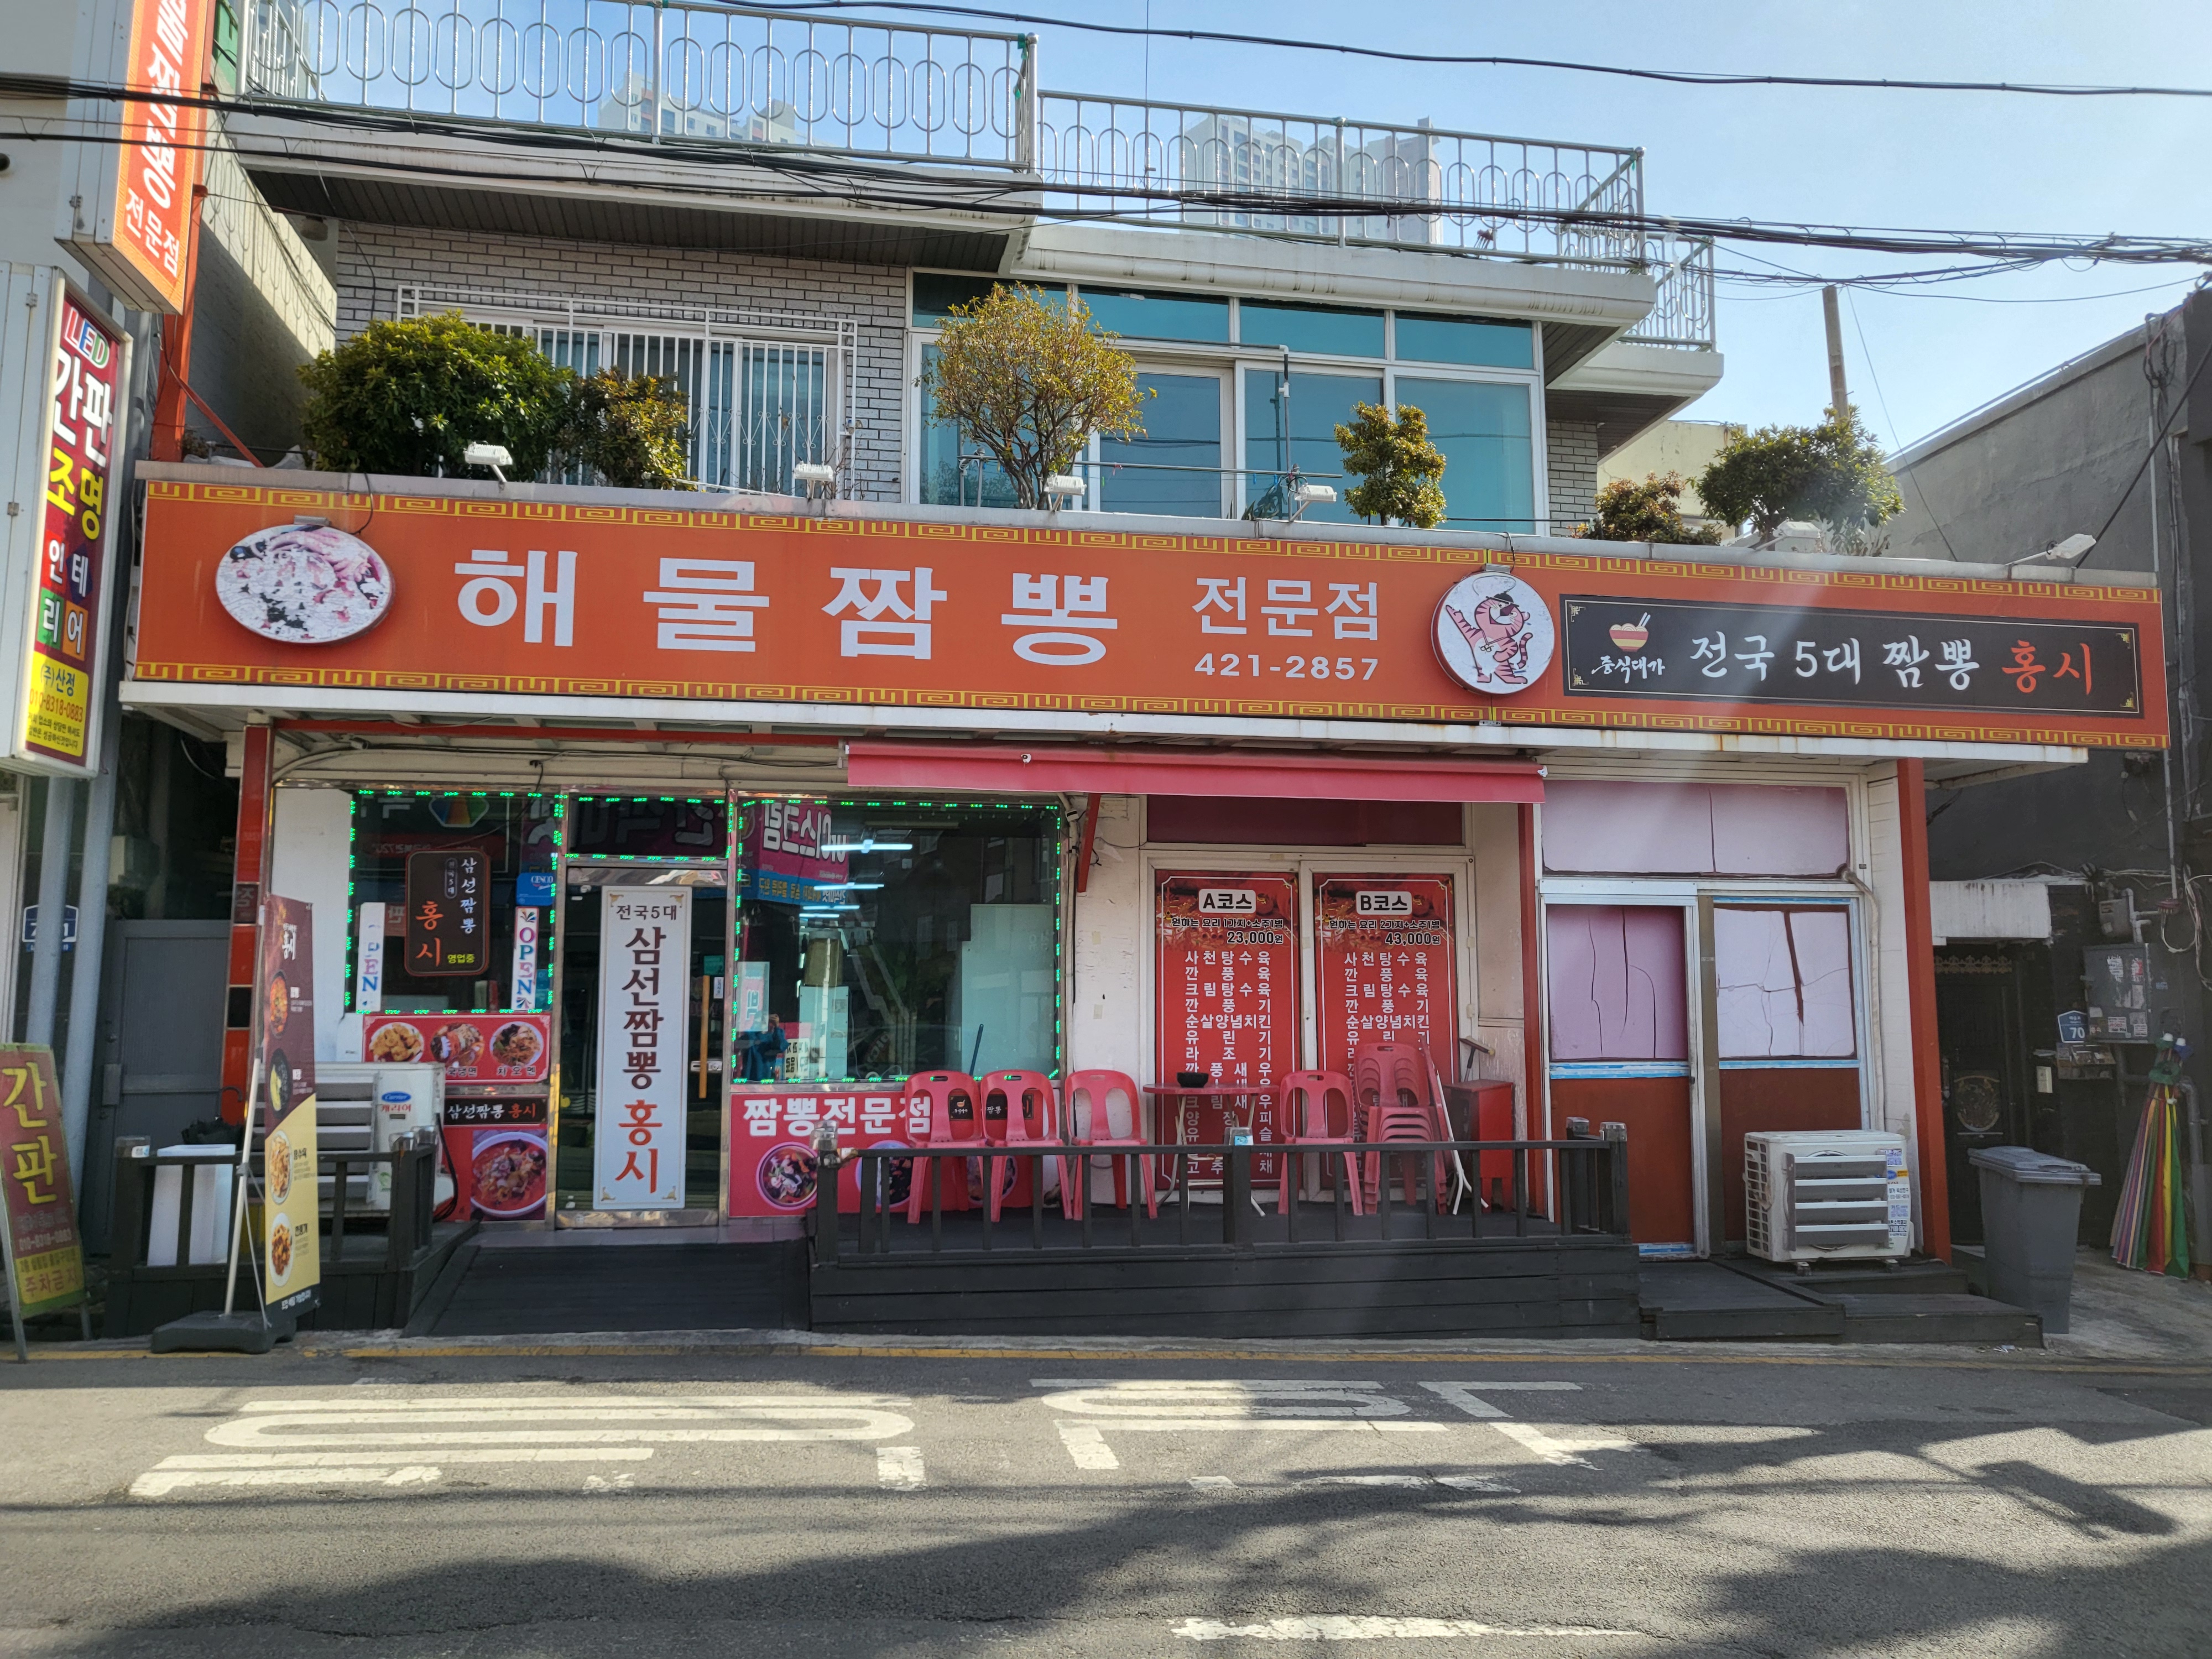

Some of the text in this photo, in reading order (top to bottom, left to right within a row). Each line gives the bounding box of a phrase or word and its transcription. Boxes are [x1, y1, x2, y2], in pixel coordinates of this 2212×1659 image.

[126, 187, 179, 278] 전문점
[64, 306, 109, 369] LED
[54, 346, 112, 468] 간판
[47, 447, 103, 540] 조명
[1192, 577, 1378, 640] 전문점
[1194, 653, 1379, 681] 421-2857
[1592, 654, 1666, 684] 중식대가
[1691, 630, 2092, 695] 전국 5대 짬뽕 홍시
[460, 857, 478, 935] 삼선짬뽕
[1203, 893, 1253, 909] A코스
[1360, 895, 1408, 911] B코스
[617, 904, 678, 922] 전국5대
[1172, 918, 1199, 927] 원하는
[1203, 918, 1220, 927] 요리
[1329, 920, 1356, 929] 원하는
[1360, 920, 1377, 929] 요리
[415, 901, 444, 967] 홍시
[1227, 931, 1283, 945] 23,000원
[1385, 933, 1441, 946] 43,000원
[447, 953, 476, 964] 영업중
[517, 927, 536, 995] OPEN
[1185, 950, 1271, 966] 사천탕수육
[1344, 952, 1428, 966] 사천탕수육
[1185, 982, 1271, 997] 크림탕수육
[1345, 983, 1428, 998] 크림탕수육
[622, 926, 666, 1090] 삼선짬뽕
[1185, 1014, 1271, 1029] 순살양념치킨
[1346, 1015, 1430, 1029] 순살양념치킨
[2069, 1027, 2085, 1039] 70
[446, 1067, 477, 1078] 국냉면
[508, 1103, 536, 1119] 홍시
[743, 1097, 931, 1137] 짬뽕전문점
[2, 1061, 58, 1204] 간판
[614, 1099, 663, 1194] 홍시
[25, 1265, 79, 1298] 주차금지
